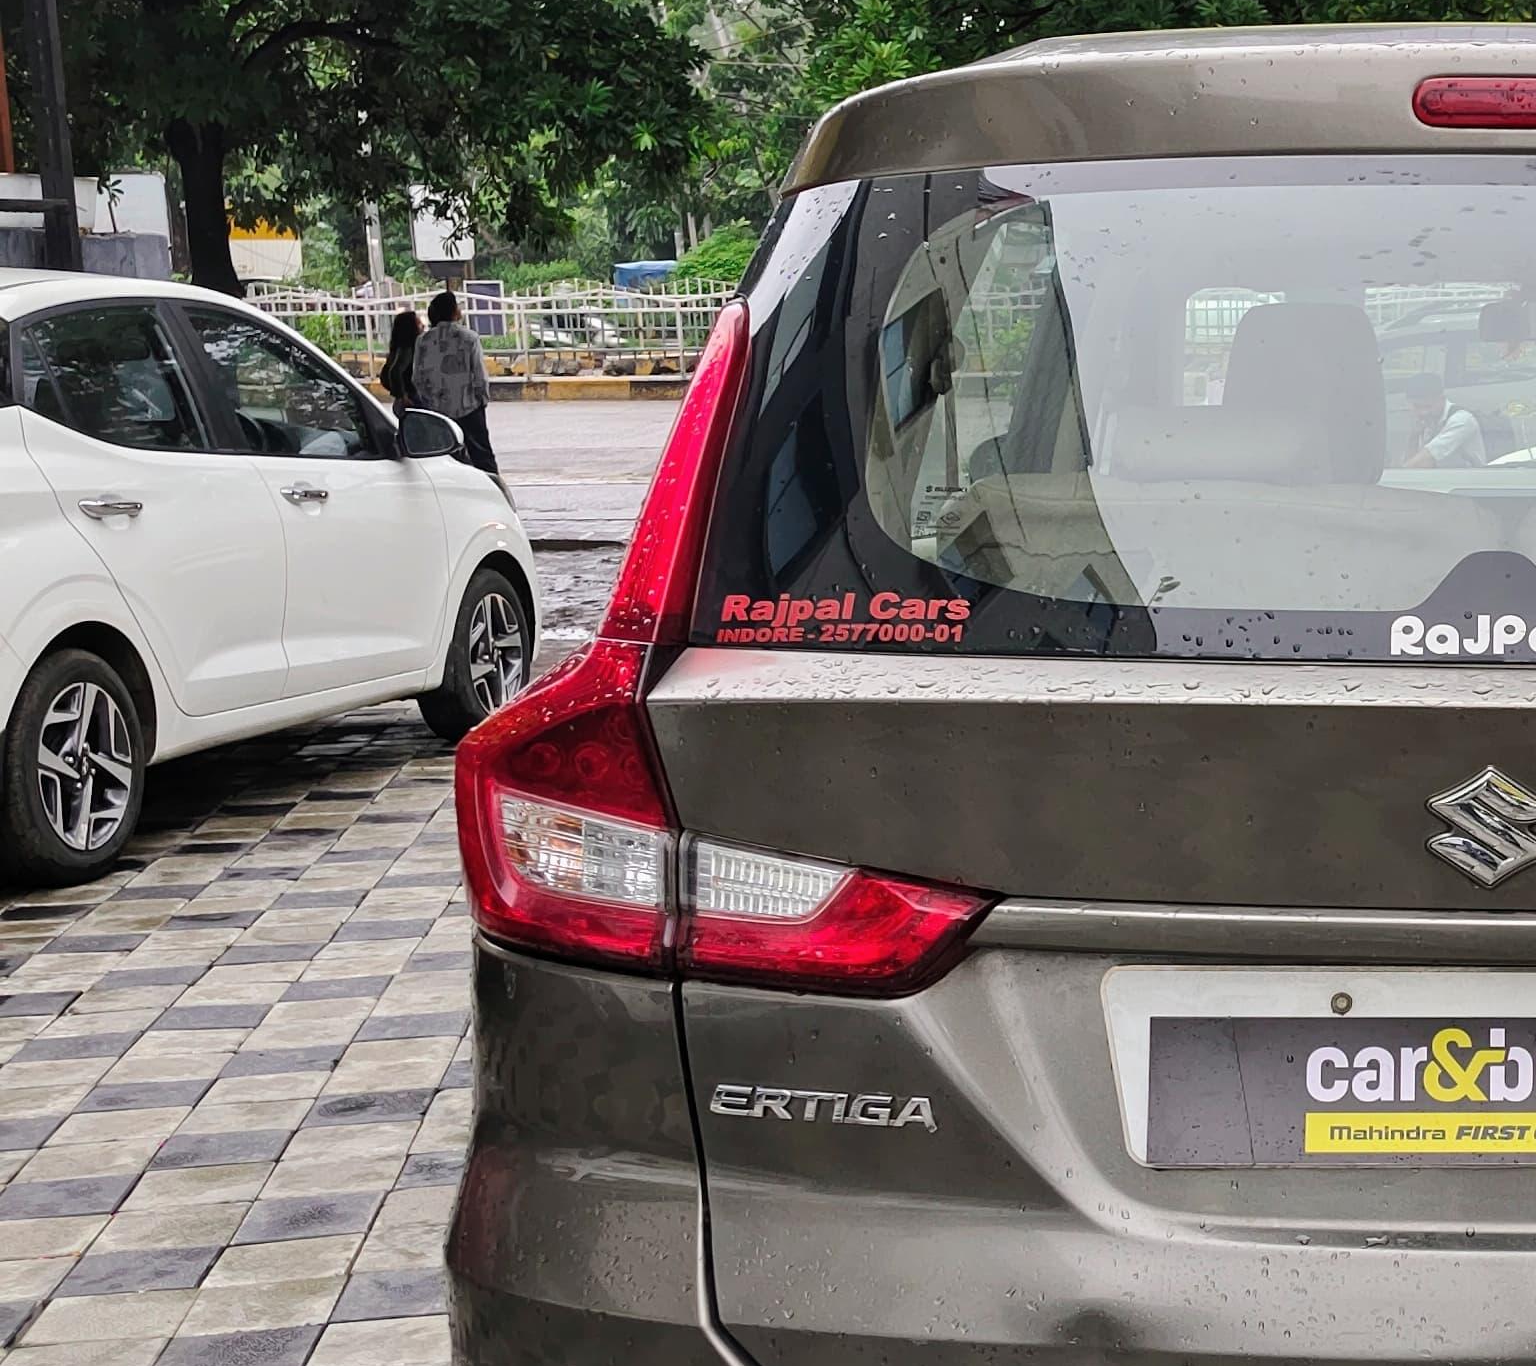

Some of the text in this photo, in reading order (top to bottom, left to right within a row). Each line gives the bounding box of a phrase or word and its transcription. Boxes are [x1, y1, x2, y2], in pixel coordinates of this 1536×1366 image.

[721, 592, 971, 627] Rajpal Cars
[716, 625, 805, 643] INDORE
[818, 623, 963, 643] 2577000-01
[710, 1084, 938, 1133] ERTIGA
[1329, 1125, 1446, 1141] Mahindra
[1455, 1125, 1532, 1141] FIRST
